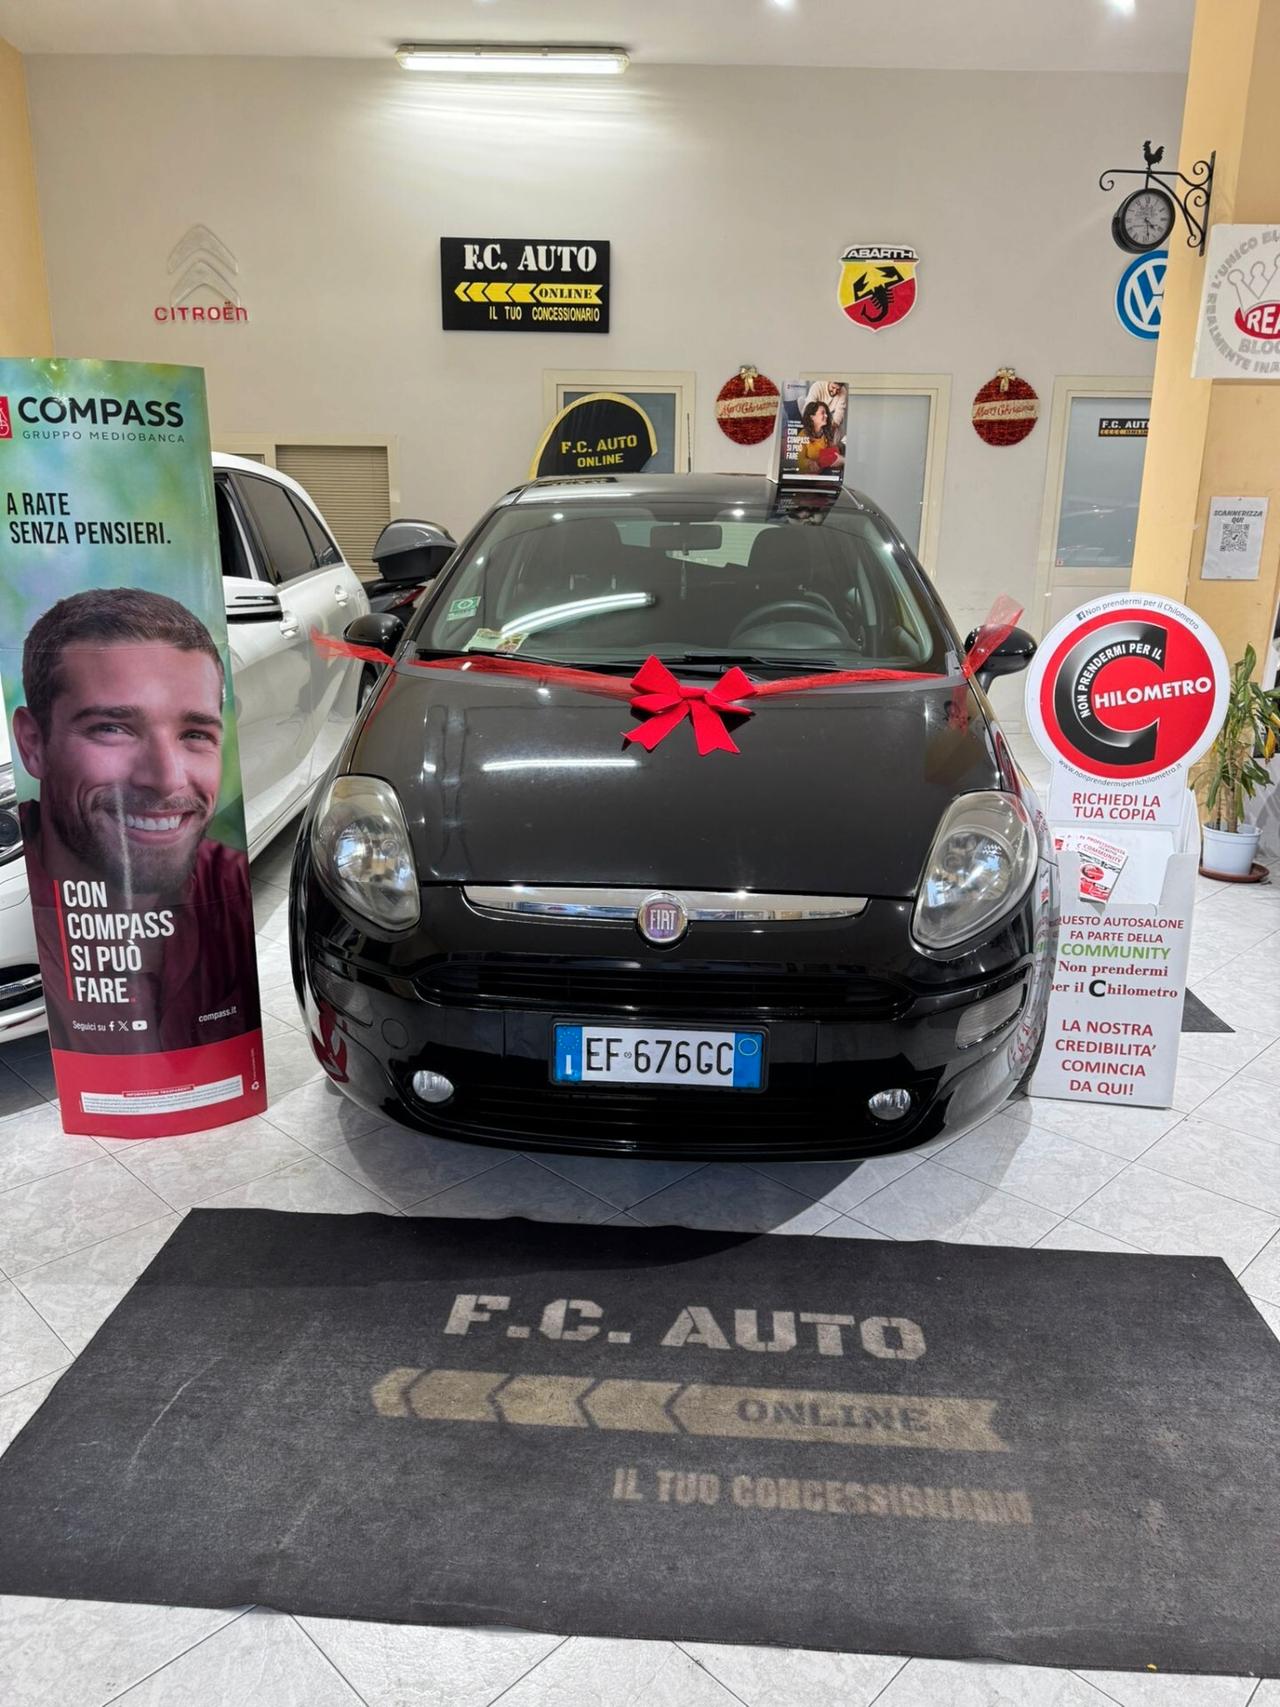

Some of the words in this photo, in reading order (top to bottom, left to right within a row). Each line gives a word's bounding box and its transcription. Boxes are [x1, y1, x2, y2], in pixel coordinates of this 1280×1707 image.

[464, 244, 508, 270] F.C.
[517, 245, 597, 272] AUTO
[847, 248, 912, 259] ABARTH
[539, 288, 593, 299] ONLINE
[154, 300, 248, 321] CITROËN
[489, 306, 498, 320] IL
[504, 306, 522, 320] TUO
[532, 307, 600, 322] CONCESSIONARIO
[18, 397, 184, 428] COMPASS
[1102, 420, 1121, 429] F.C.
[23, 430, 82, 441] GRUPPO
[90, 431, 185, 443] MEDIOBANCA
[561, 441, 592, 454] F.C.
[596, 434, 638, 452] AUTO
[577, 453, 624, 468] ONLINE
[7, 493, 18, 515] A
[23, 493, 71, 515] RATE
[10, 522, 69, 544] SENZA
[76, 522, 171, 545] PENSIERI.
[1085, 605, 1101, 616] Non
[1102, 598, 1142, 610] prendermi
[1164, 603, 1199, 630] Chilometro
[1129, 643, 1151, 655] PER
[1151, 647, 1162, 660] IL
[1078, 644, 1126, 691] PRENDERMI
[1077, 694, 1091, 718] NON
[1058, 758, 1183, 788] www.nonprendermiperilchilometro.it
[1072, 792, 1138, 806] RICHIEDI
[1143, 795, 1161, 808] LA
[1074, 806, 1104, 819] TUA
[1109, 807, 1156, 821] COPIA
[62, 880, 108, 908] CON
[67, 910, 175, 940] COMPASS
[650, 909, 676, 930] FIAT
[1103, 917, 1184, 929] AUTOSALONE
[1070, 930, 1084, 940] FA
[1088, 931, 1124, 941] PARTE
[1127, 933, 1163, 943] DELLA
[71, 945, 91, 971] SI
[97, 940, 142, 972] PUÒ
[1061, 943, 1171, 960] COMMUNITY
[1058, 961, 1087, 973] Non
[1091, 964, 1168, 977] prendermi
[1074, 982, 1084, 993] il
[1088, 979, 1178, 998] Chilometro
[199, 1006, 237, 1022] compass.it
[72, 1020, 97, 1032] Seguici
[1062, 1019, 1081, 1032] LA
[1087, 1021, 1153, 1036] NOSTRA
[565, 1055, 572, 1075] I
[1061, 1059, 1146, 1077] COMINCIA
[1070, 1079, 1092, 1092] DA
[1097, 1082, 1134, 1096] QUI!
[444, 1294, 631, 1343] F.C.
[660, 1306, 927, 1360] AUTO
[737, 1398, 931, 1432] ONLINE
[613, 1468, 643, 1500] IL
[656, 1470, 720, 1505] TUO
